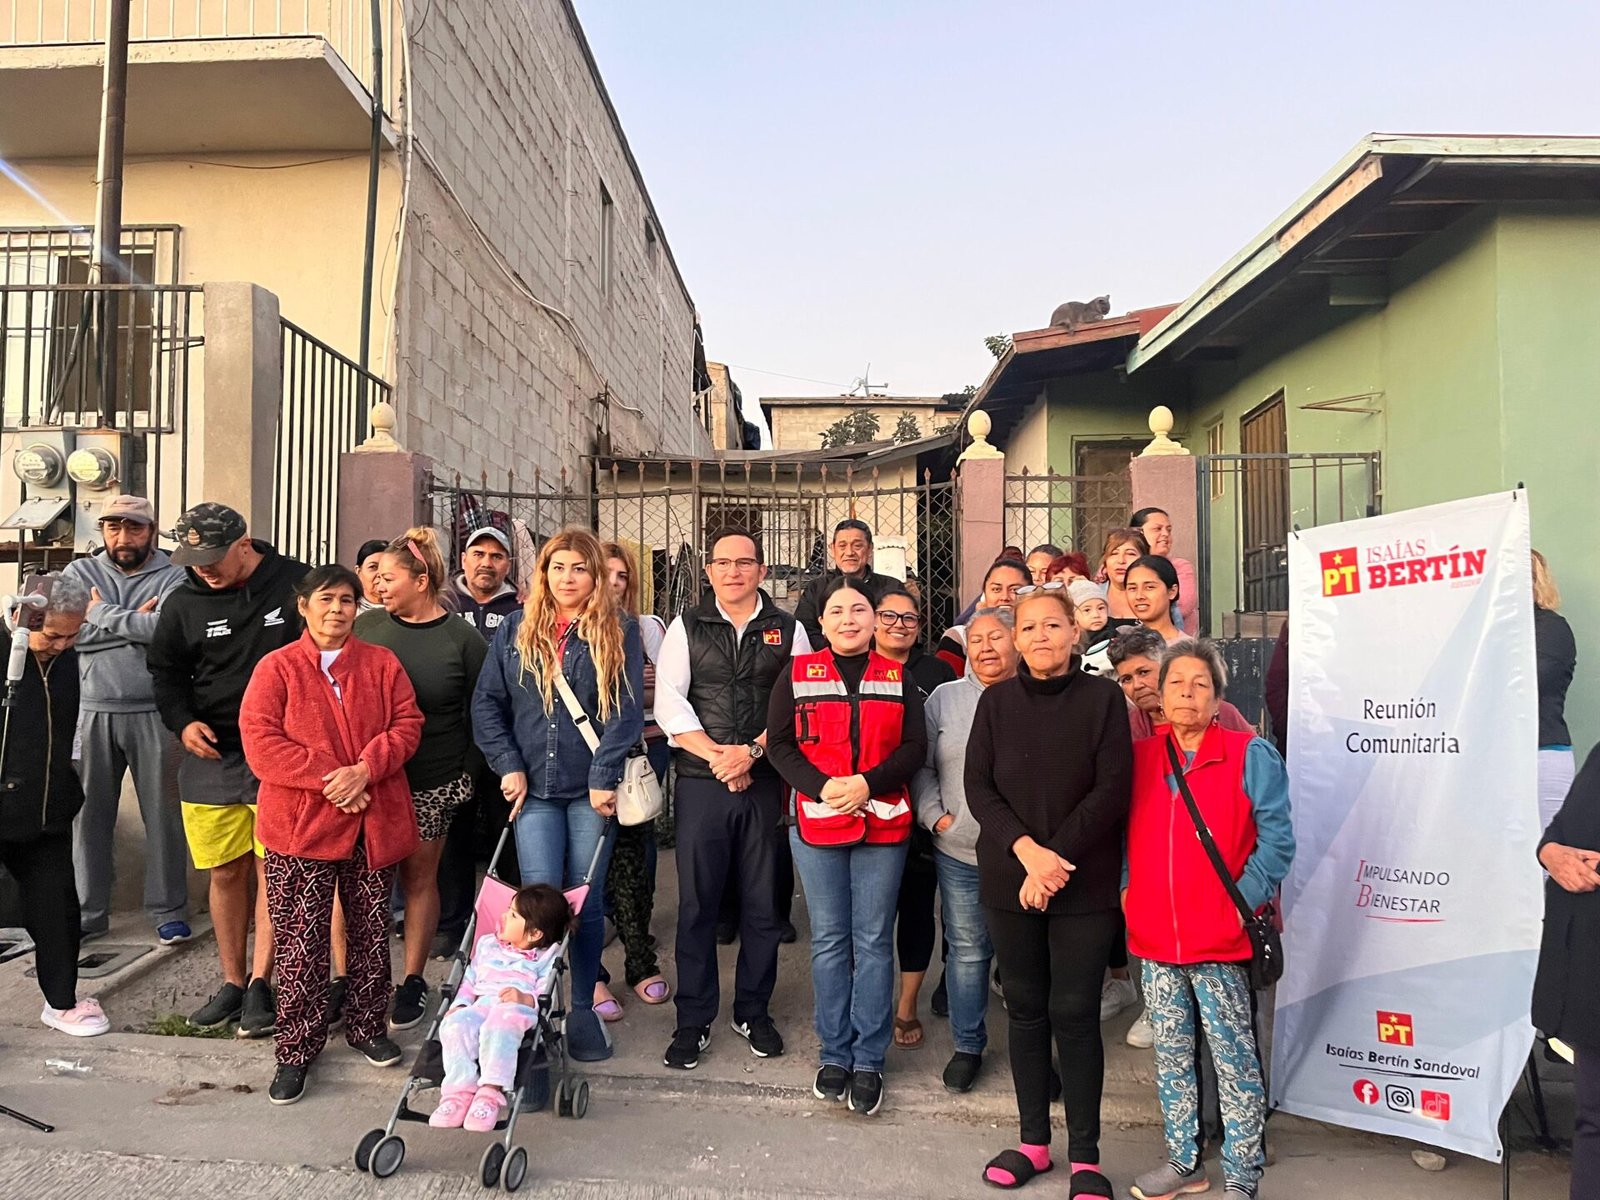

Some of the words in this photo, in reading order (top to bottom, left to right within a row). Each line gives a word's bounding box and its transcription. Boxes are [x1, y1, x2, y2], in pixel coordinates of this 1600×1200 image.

[1366, 539, 1426, 565] ISAÍAS
[1367, 544, 1487, 589] BERTÍN
[1323, 565, 1357, 595] PT
[765, 633, 780, 643] PT
[808, 667, 823, 676] PT
[886, 669, 899, 680] 4T
[1364, 697, 1436, 719] Reunión
[1346, 732, 1460, 753] Comunitaria
[1354, 860, 1450, 886] IMPULSANDO
[1356, 884, 1441, 913] BIENESTAR
[1379, 1023, 1411, 1044] PT
[1326, 1043, 1364, 1060] Isaías
[1368, 1051, 1409, 1068] Bertín
[1413, 1058, 1480, 1079] Sandoval
